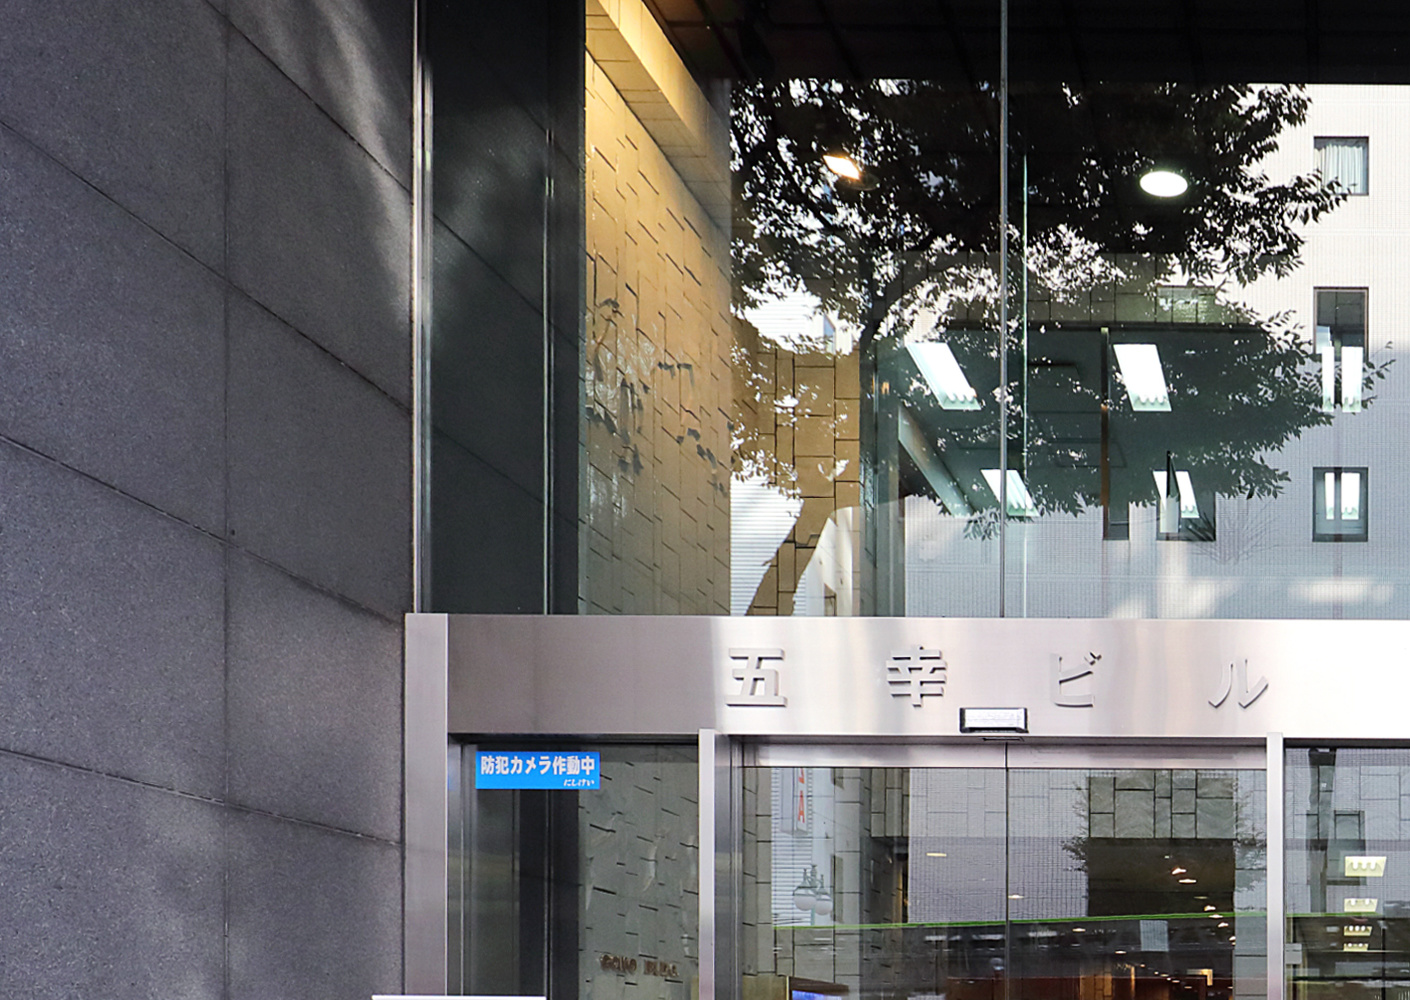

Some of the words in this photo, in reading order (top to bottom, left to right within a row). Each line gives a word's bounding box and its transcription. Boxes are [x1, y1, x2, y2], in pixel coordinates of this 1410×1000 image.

[725, 645, 1270, 709] 五幸ビル
[480, 755, 595, 775] 防犯カメラ作動中
